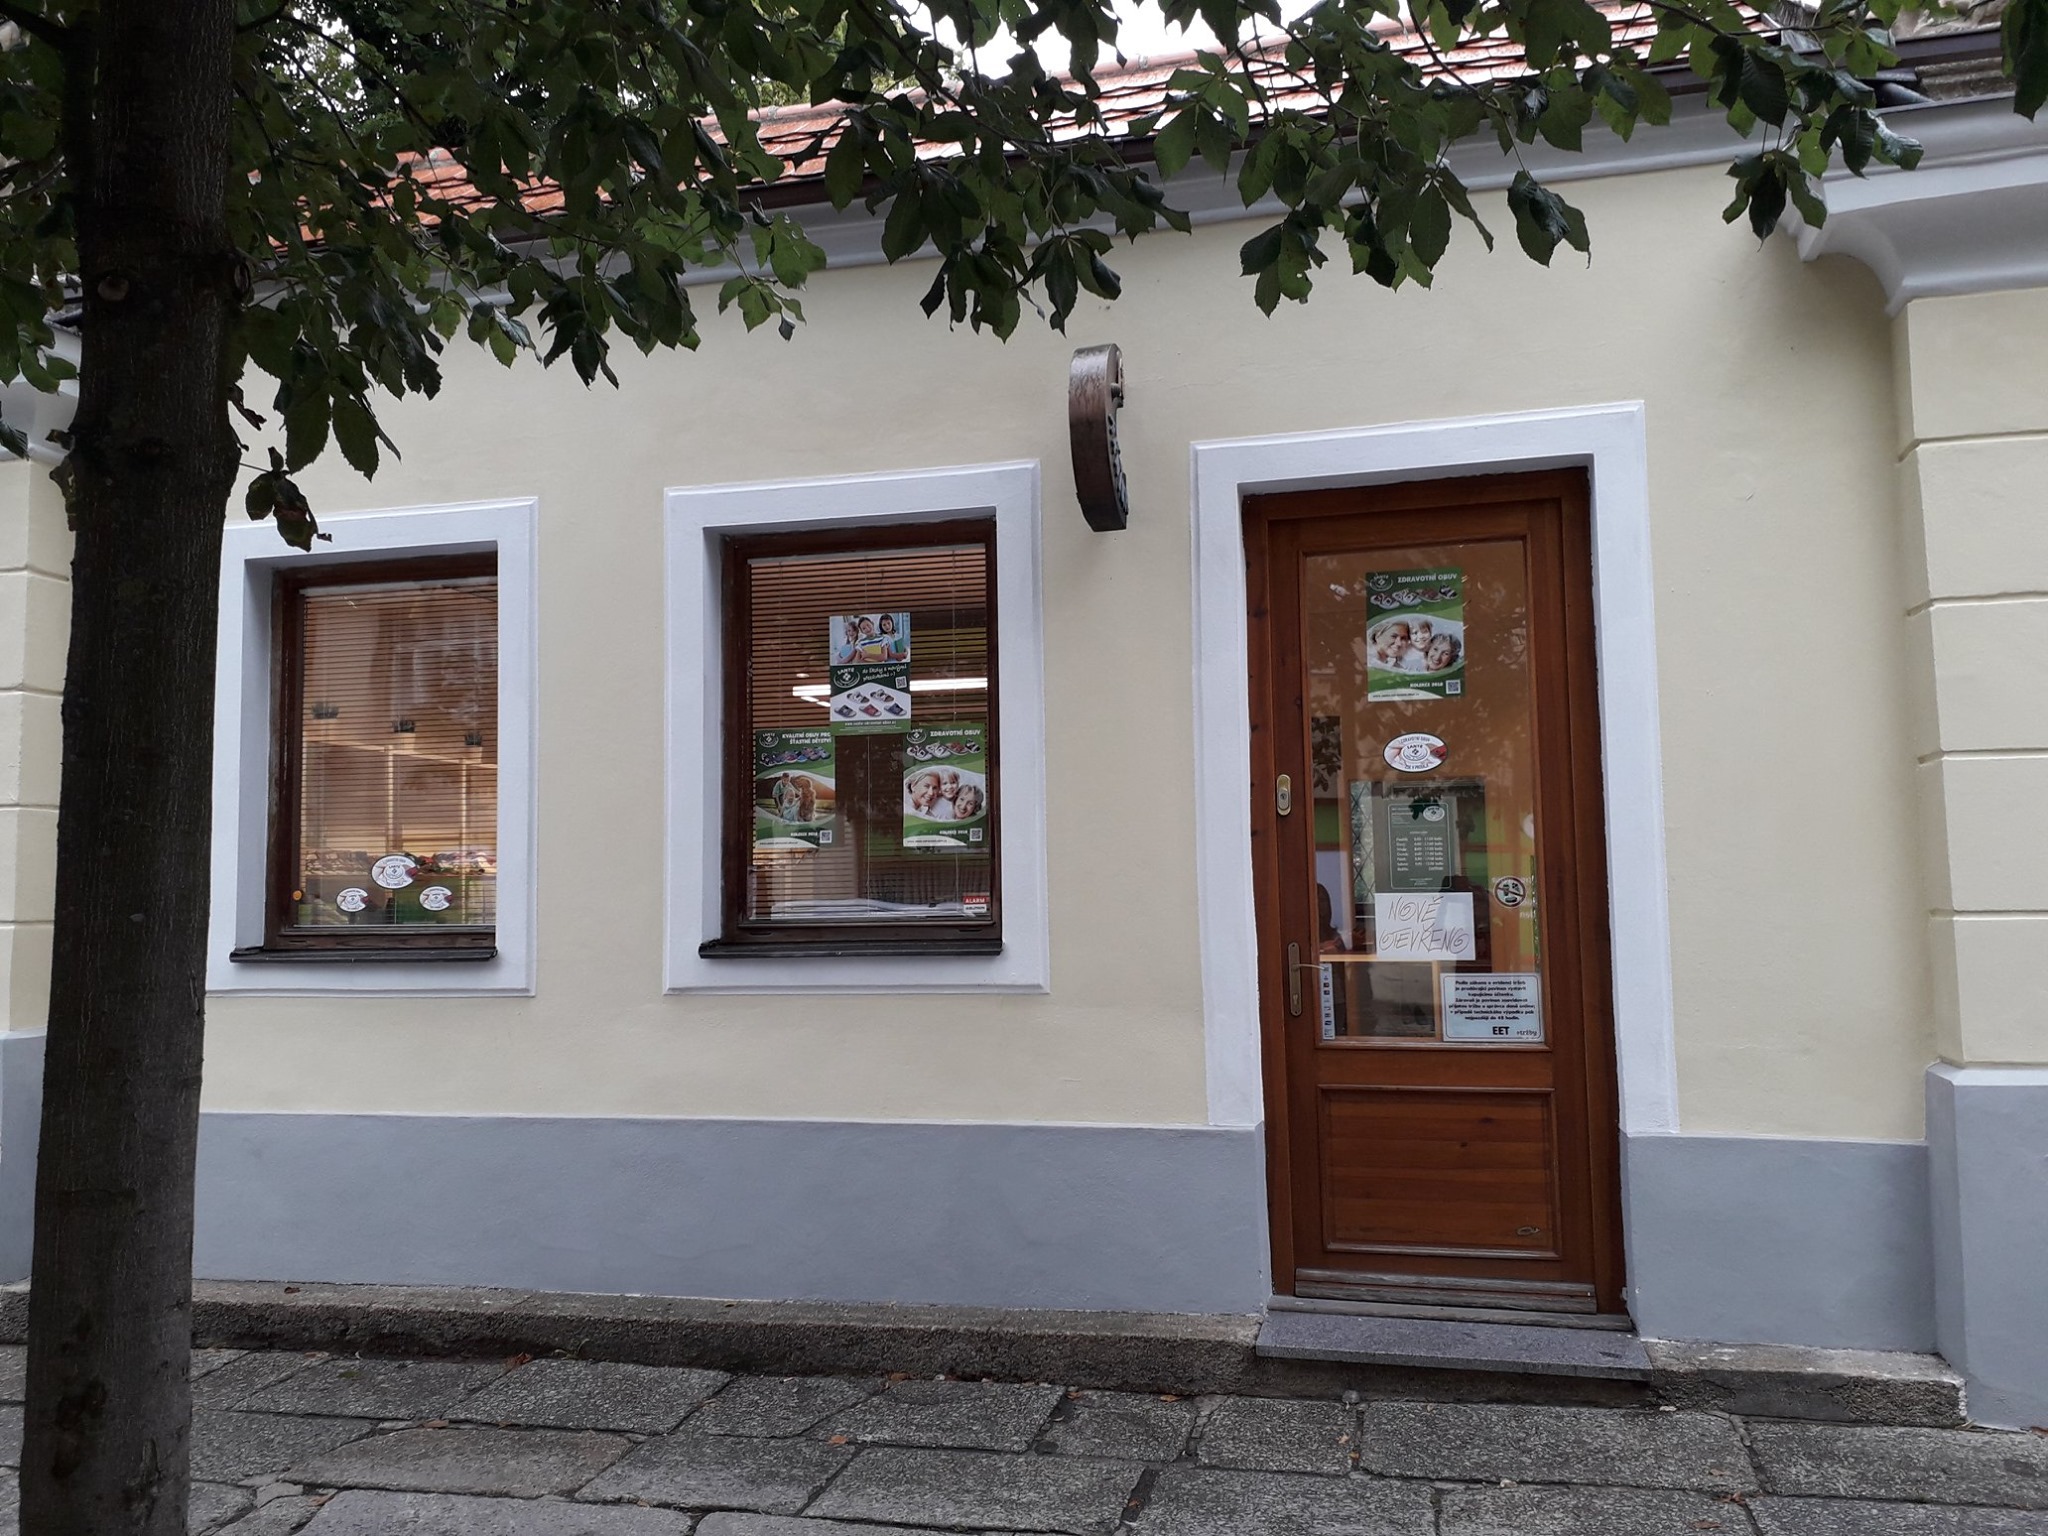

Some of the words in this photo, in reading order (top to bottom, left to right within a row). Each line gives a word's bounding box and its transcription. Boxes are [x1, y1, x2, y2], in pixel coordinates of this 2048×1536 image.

[1398, 573, 1436, 583] ZDRAVOTNÍ
[1388, 896, 1444, 923] NOVÉ
[1379, 922, 1470, 954] OTEVŘENO
[1492, 1026, 1510, 1035] EET
